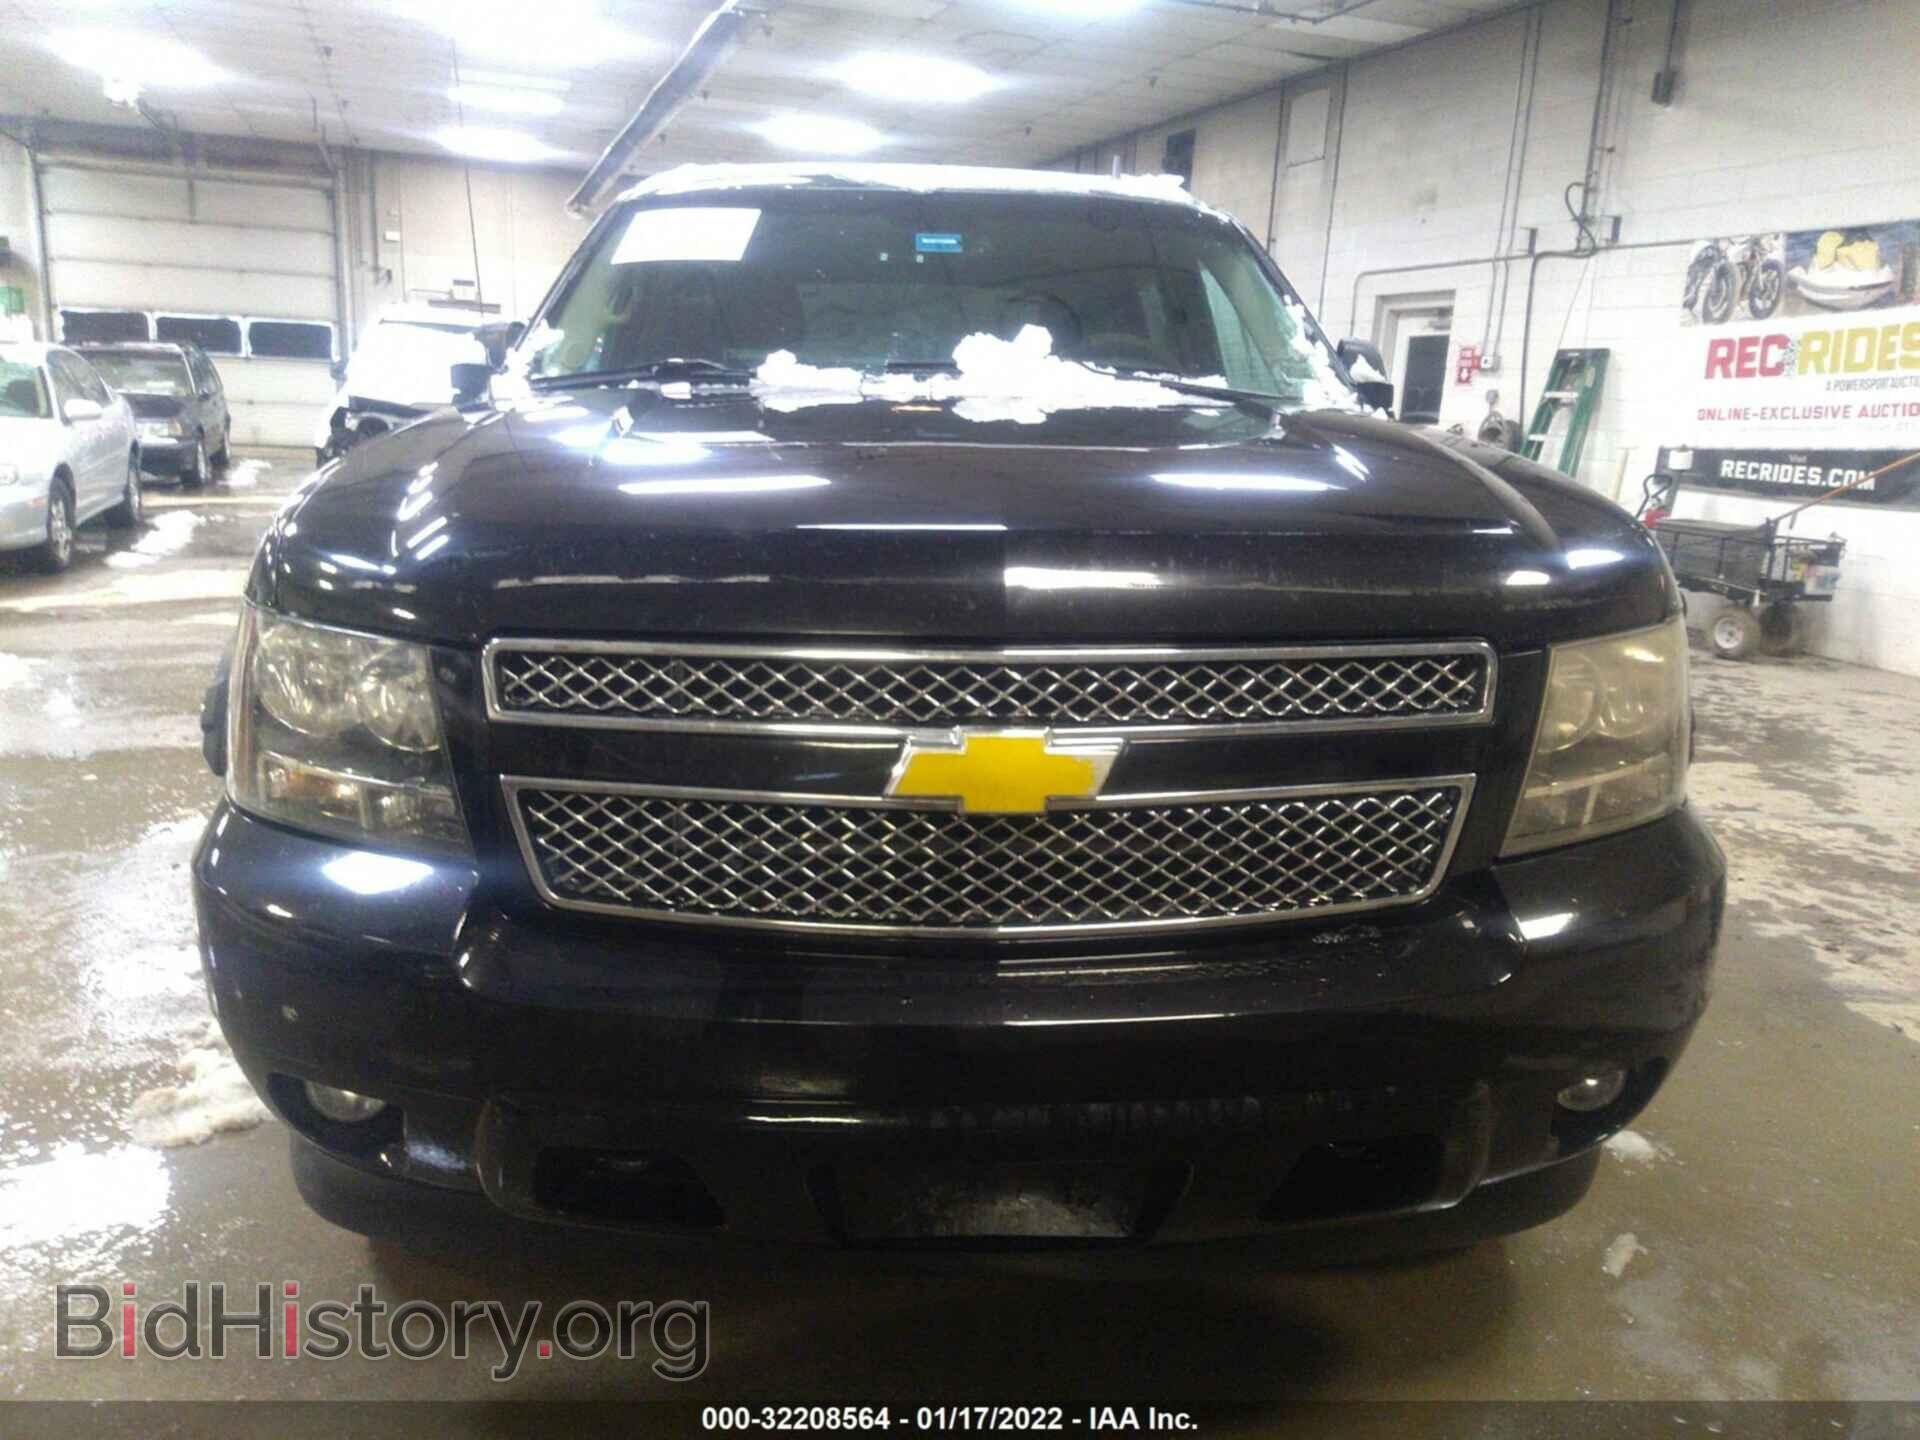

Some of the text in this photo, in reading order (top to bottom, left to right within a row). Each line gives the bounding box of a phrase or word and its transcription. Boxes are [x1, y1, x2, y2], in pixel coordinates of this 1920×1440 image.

[1704, 322, 1920, 380] REC RIDES
[1697, 404, 1851, 421] ONLINE-EXCLUSIVE
[1720, 459, 1876, 491] RECRIDES.COM
